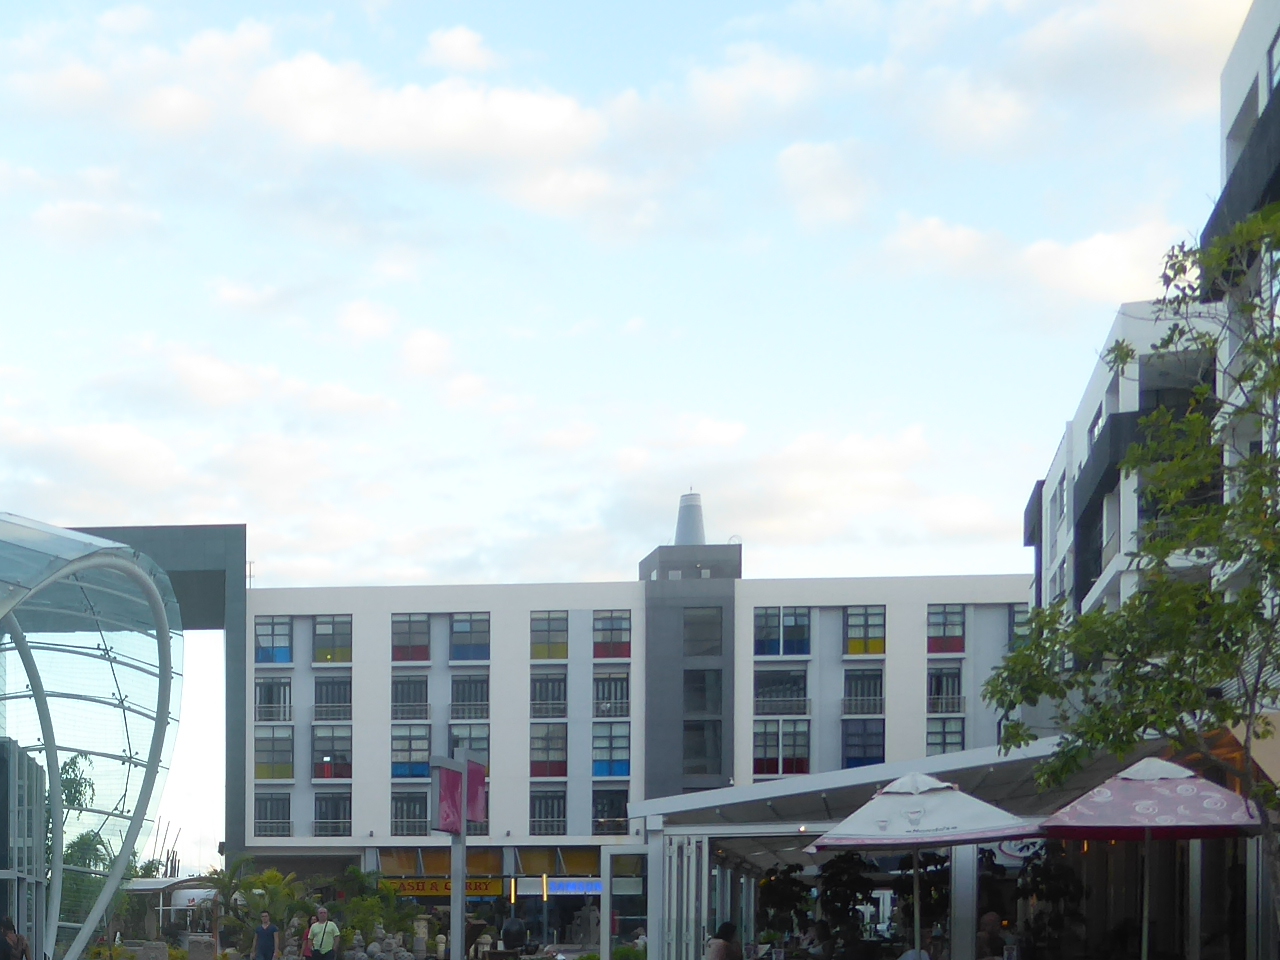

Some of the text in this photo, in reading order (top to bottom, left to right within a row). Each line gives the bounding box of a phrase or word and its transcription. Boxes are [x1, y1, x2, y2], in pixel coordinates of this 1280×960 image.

[429, 881, 439, 892] &
[444, 881, 492, 892] CRRY
[548, 881, 603, 892] SAMSUN
